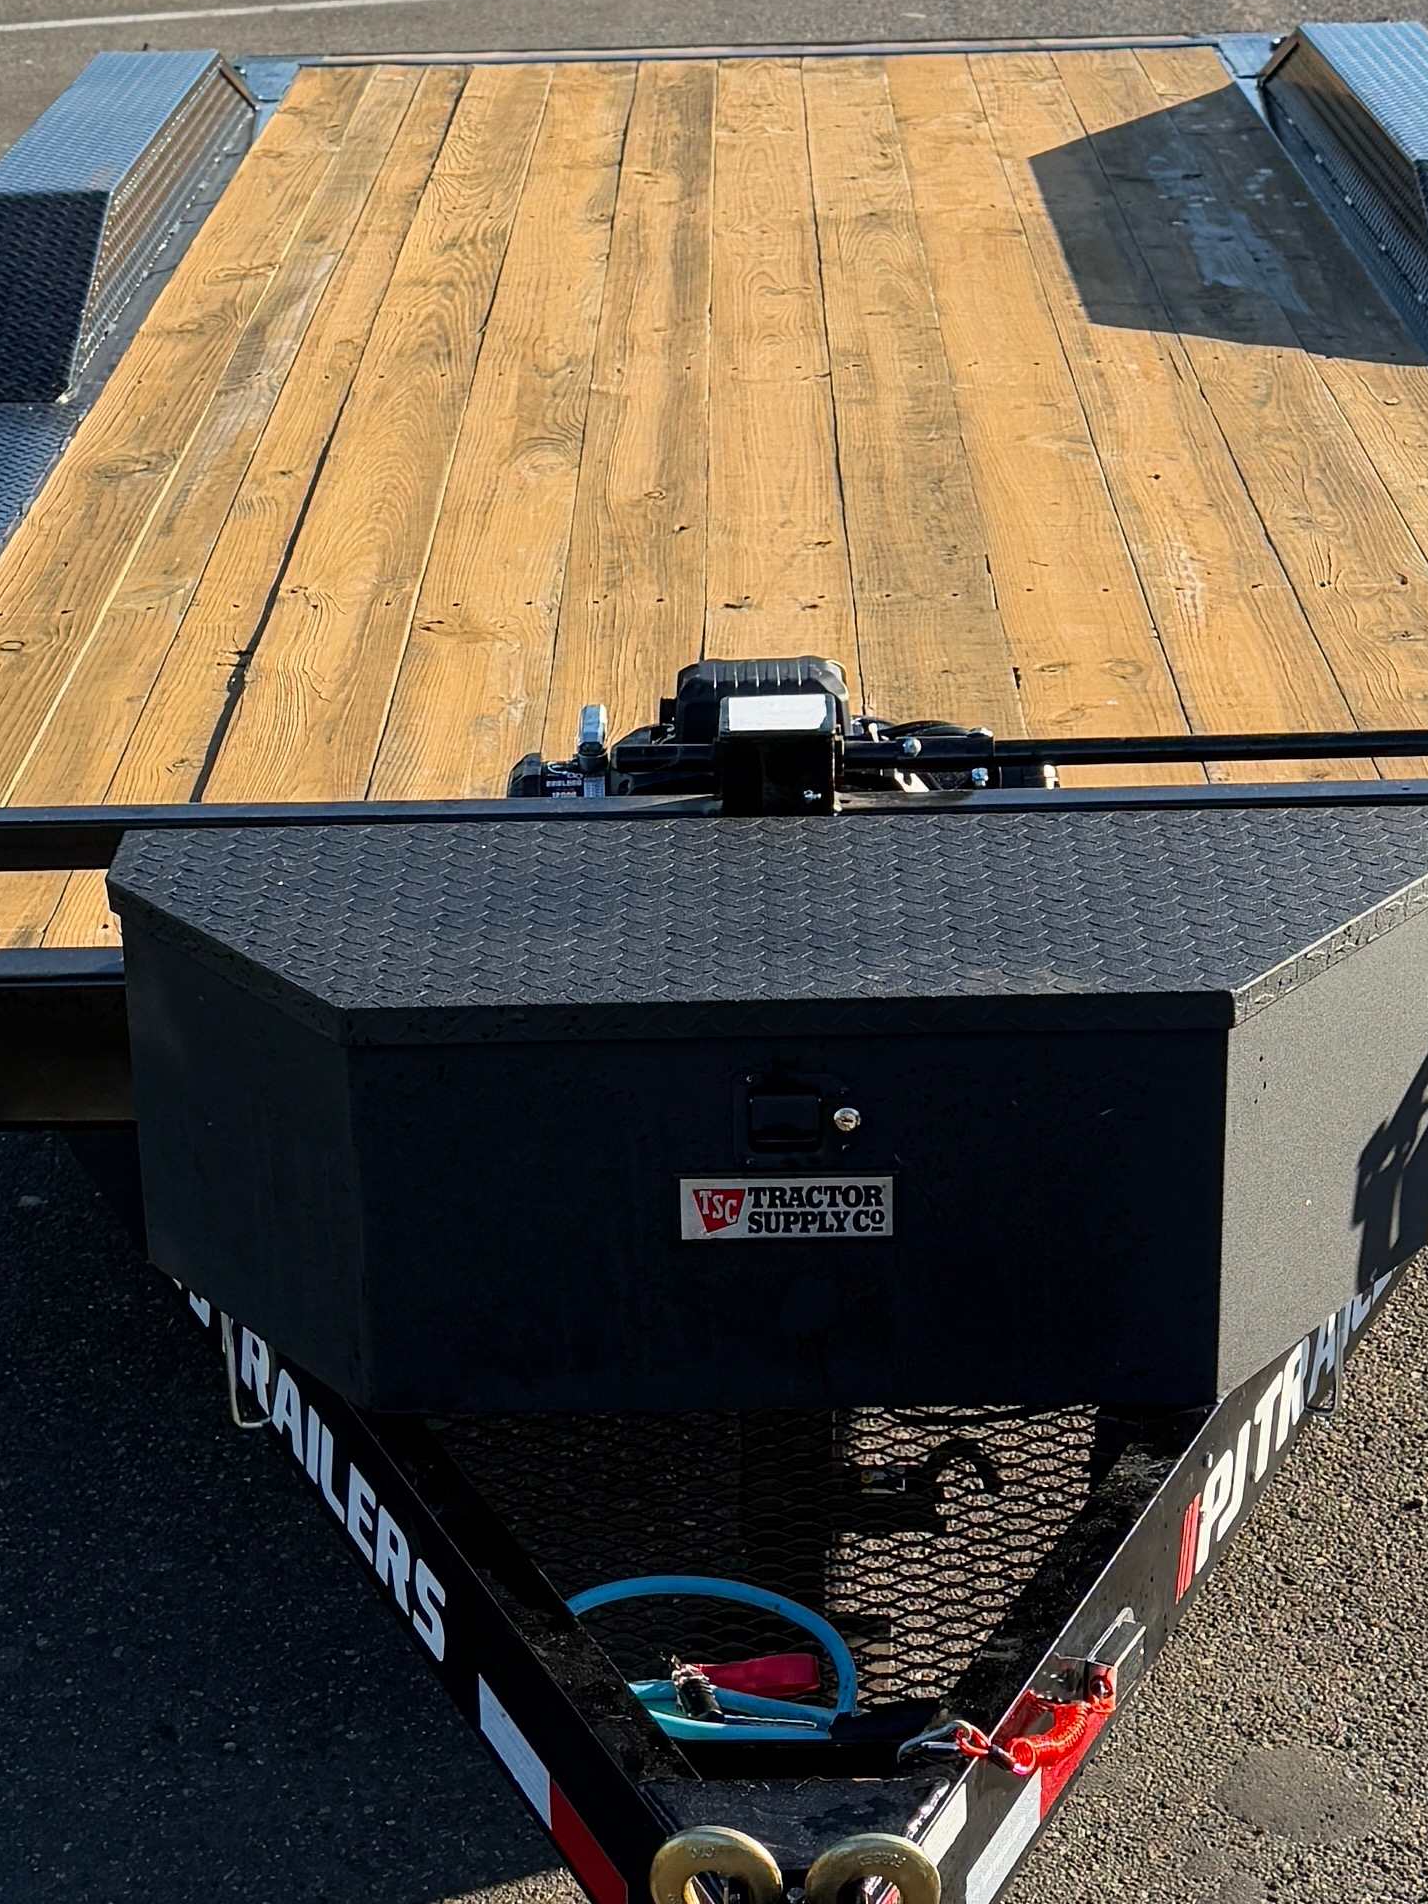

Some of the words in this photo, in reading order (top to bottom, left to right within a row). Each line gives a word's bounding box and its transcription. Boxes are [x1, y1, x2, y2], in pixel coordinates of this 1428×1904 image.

[699, 1190, 738, 1224] TSC
[747, 1185, 884, 1209] TRACTOR
[747, 1210, 851, 1234] SUPPLY
[1194, 1419, 1252, 1575] PJ
